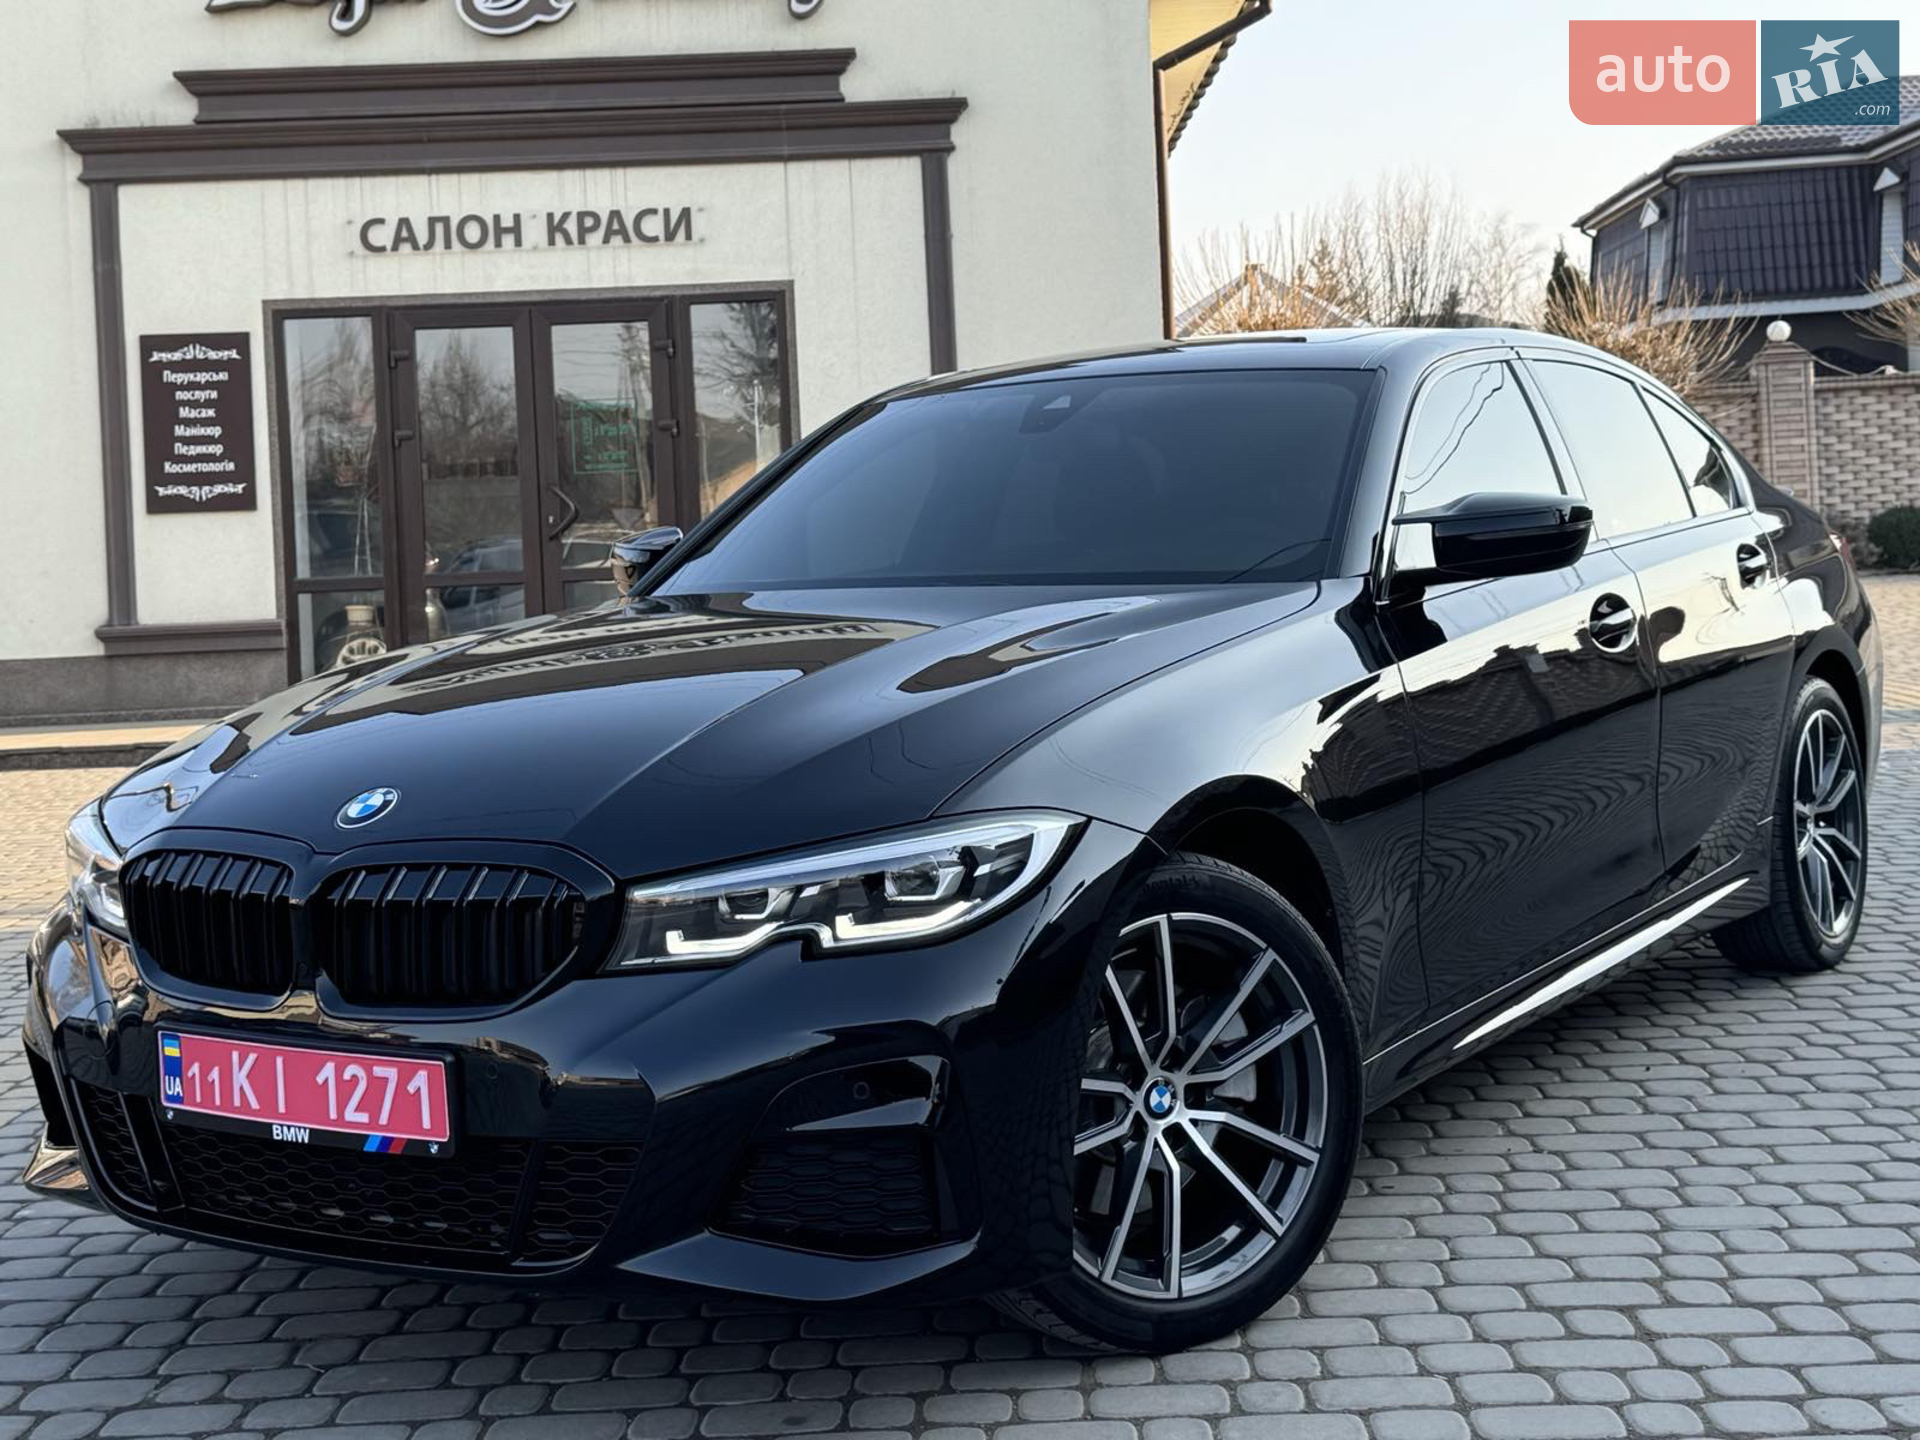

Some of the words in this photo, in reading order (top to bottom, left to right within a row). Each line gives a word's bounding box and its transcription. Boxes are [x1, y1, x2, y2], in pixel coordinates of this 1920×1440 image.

[359, 213, 523, 253] САЛОН
[546, 206, 693, 247] КРАСИ
[163, 370, 229, 385] Перукарські
[175, 389, 218, 403] послуги
[179, 406, 216, 419] Масаж
[174, 424, 222, 438] Манікюр
[174, 442, 224, 456] Педикюр
[164, 460, 236, 474] Косметологія
[164, 1075, 183, 1098] UA
[315, 1060, 432, 1131] 1271
[272, 1124, 310, 1144] BMW
